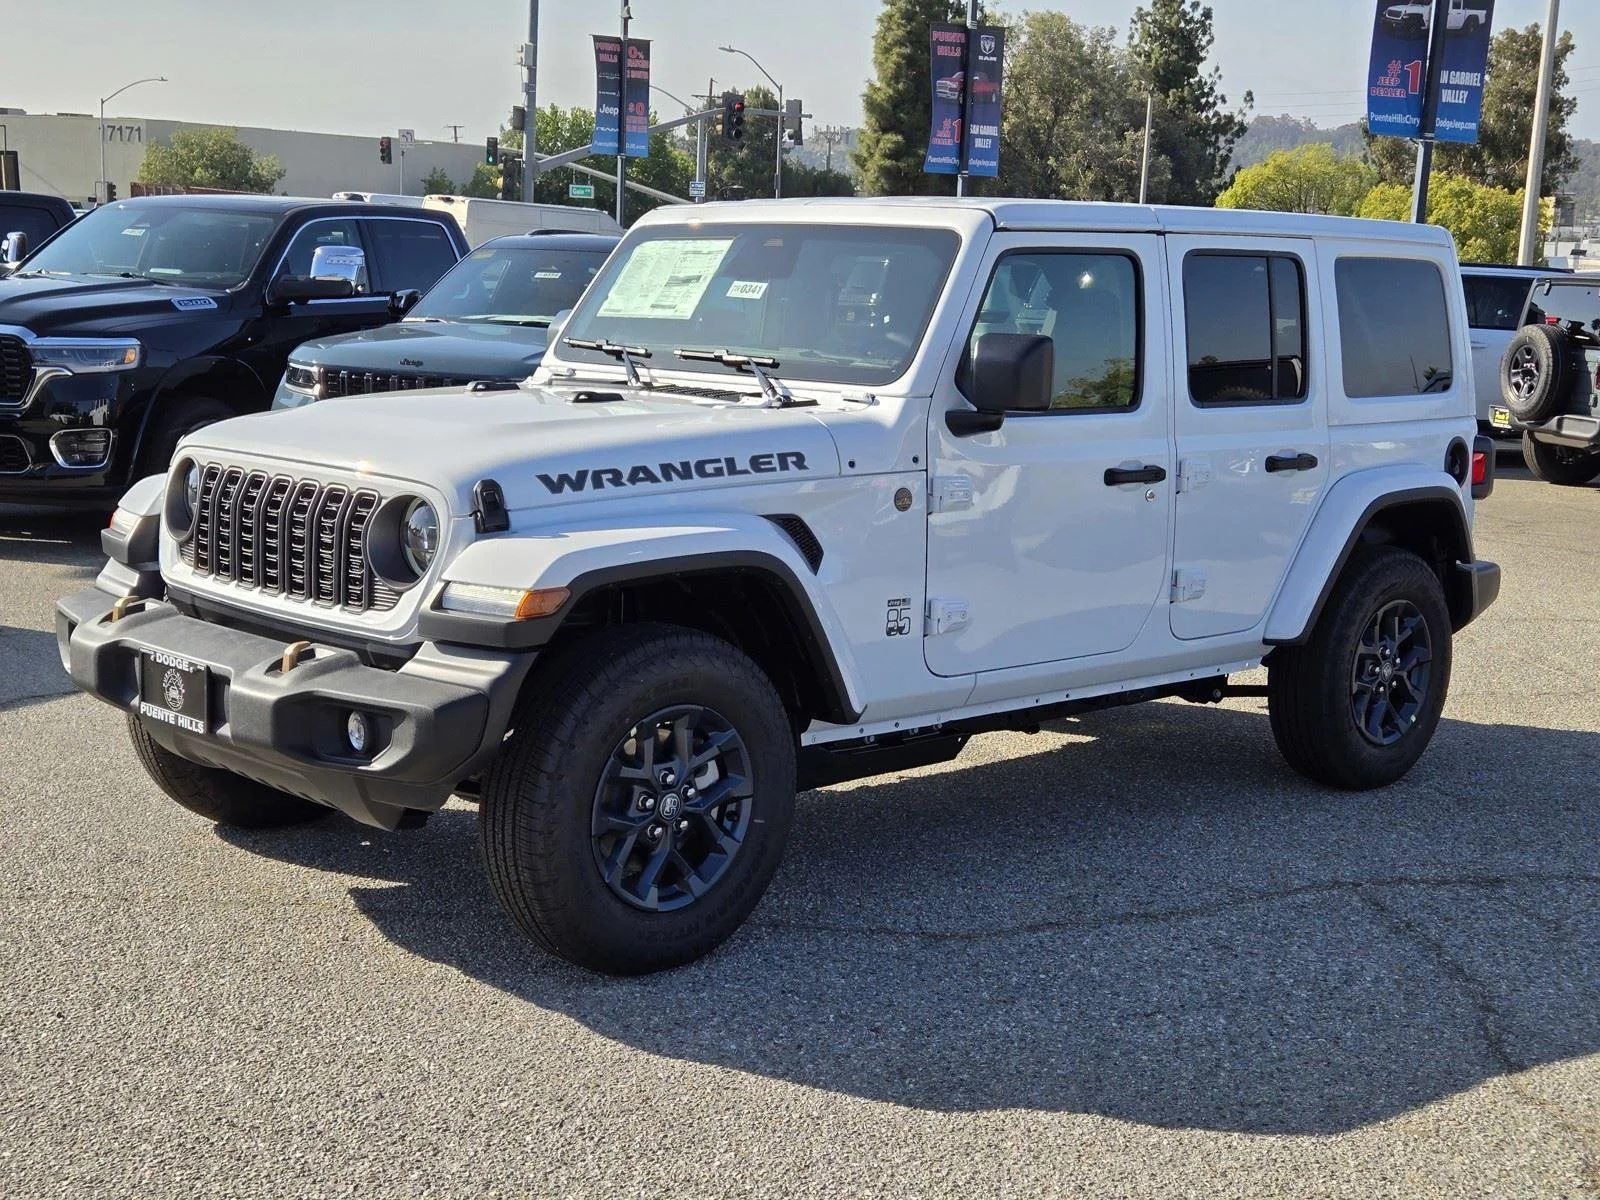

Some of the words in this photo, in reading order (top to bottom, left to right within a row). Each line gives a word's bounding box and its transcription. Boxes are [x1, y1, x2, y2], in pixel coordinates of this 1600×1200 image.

[937, 46, 961, 57] HILLS
[1377, 76, 1400, 86] JEEP
[1450, 71, 1481, 86] GABRIEL
[1370, 87, 1406, 98] DEALER
[1442, 89, 1468, 104] VALLEY
[599, 103, 619, 116] Jeep
[974, 138, 992, 149] VALLEY
[740, 283, 763, 294] 0341
[178, 299, 210, 307] 1500
[535, 451, 810, 494] WRANGLER
[886, 607, 911, 636] 85
[155, 652, 190, 672] DODGE
[140, 703, 175, 725] PUENTE
[178, 715, 204, 734] HILLS
